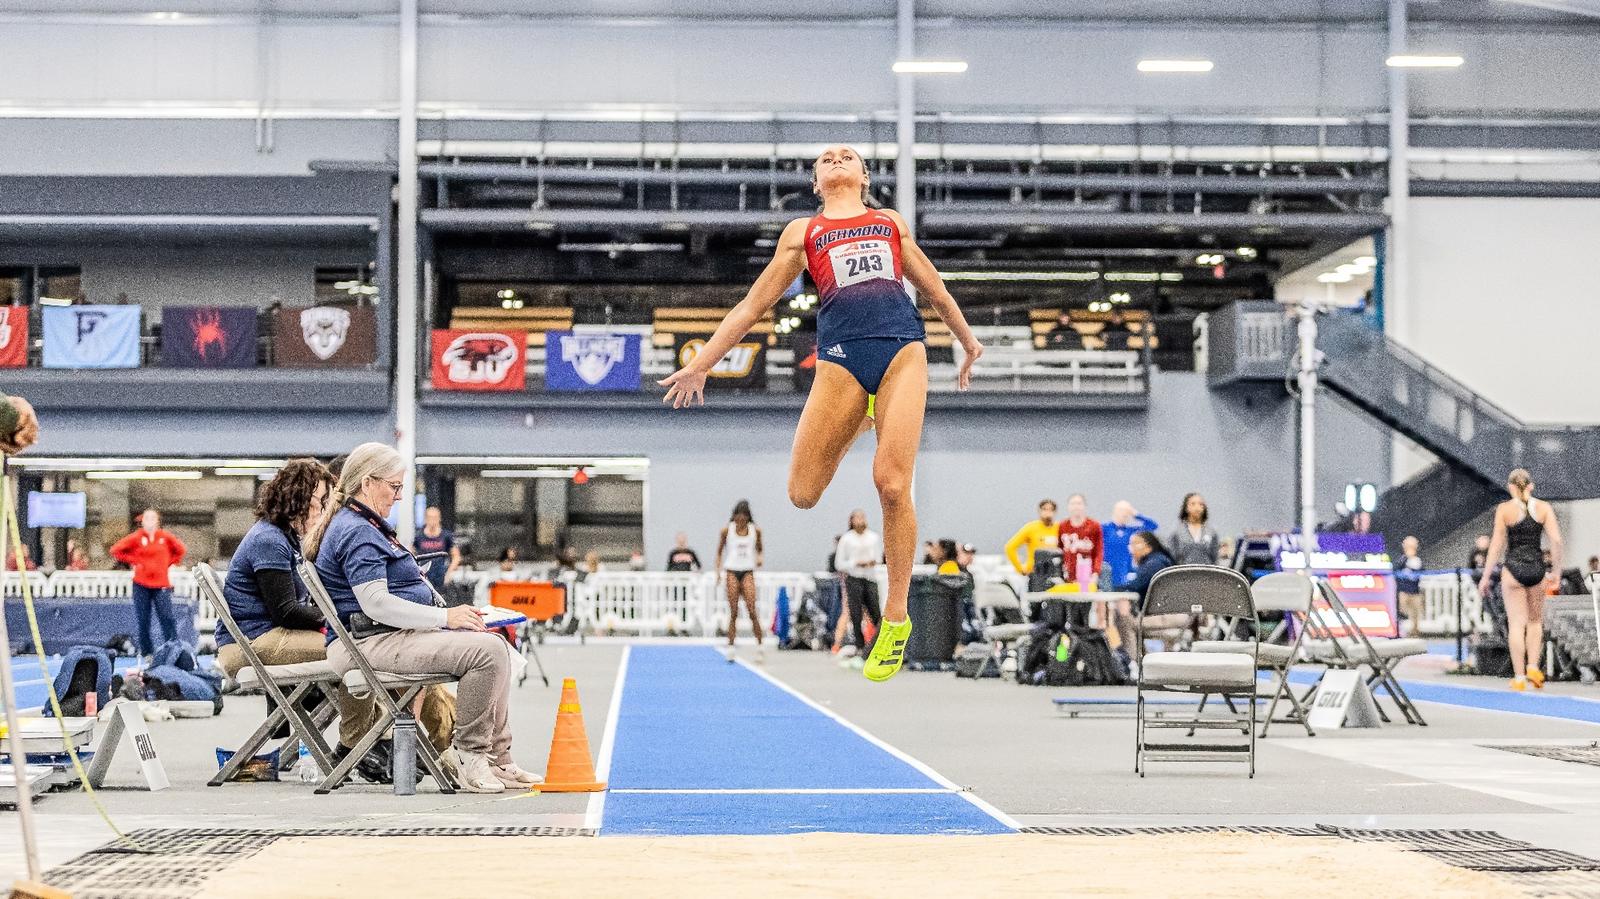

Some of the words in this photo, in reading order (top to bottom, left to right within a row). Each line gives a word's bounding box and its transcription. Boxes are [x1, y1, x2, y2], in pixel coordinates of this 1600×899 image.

[814, 224, 893, 252] RICHMOND
[845, 254, 883, 277] 243
[1317, 691, 1347, 708] GILL
[135, 733, 156, 761] GILL
